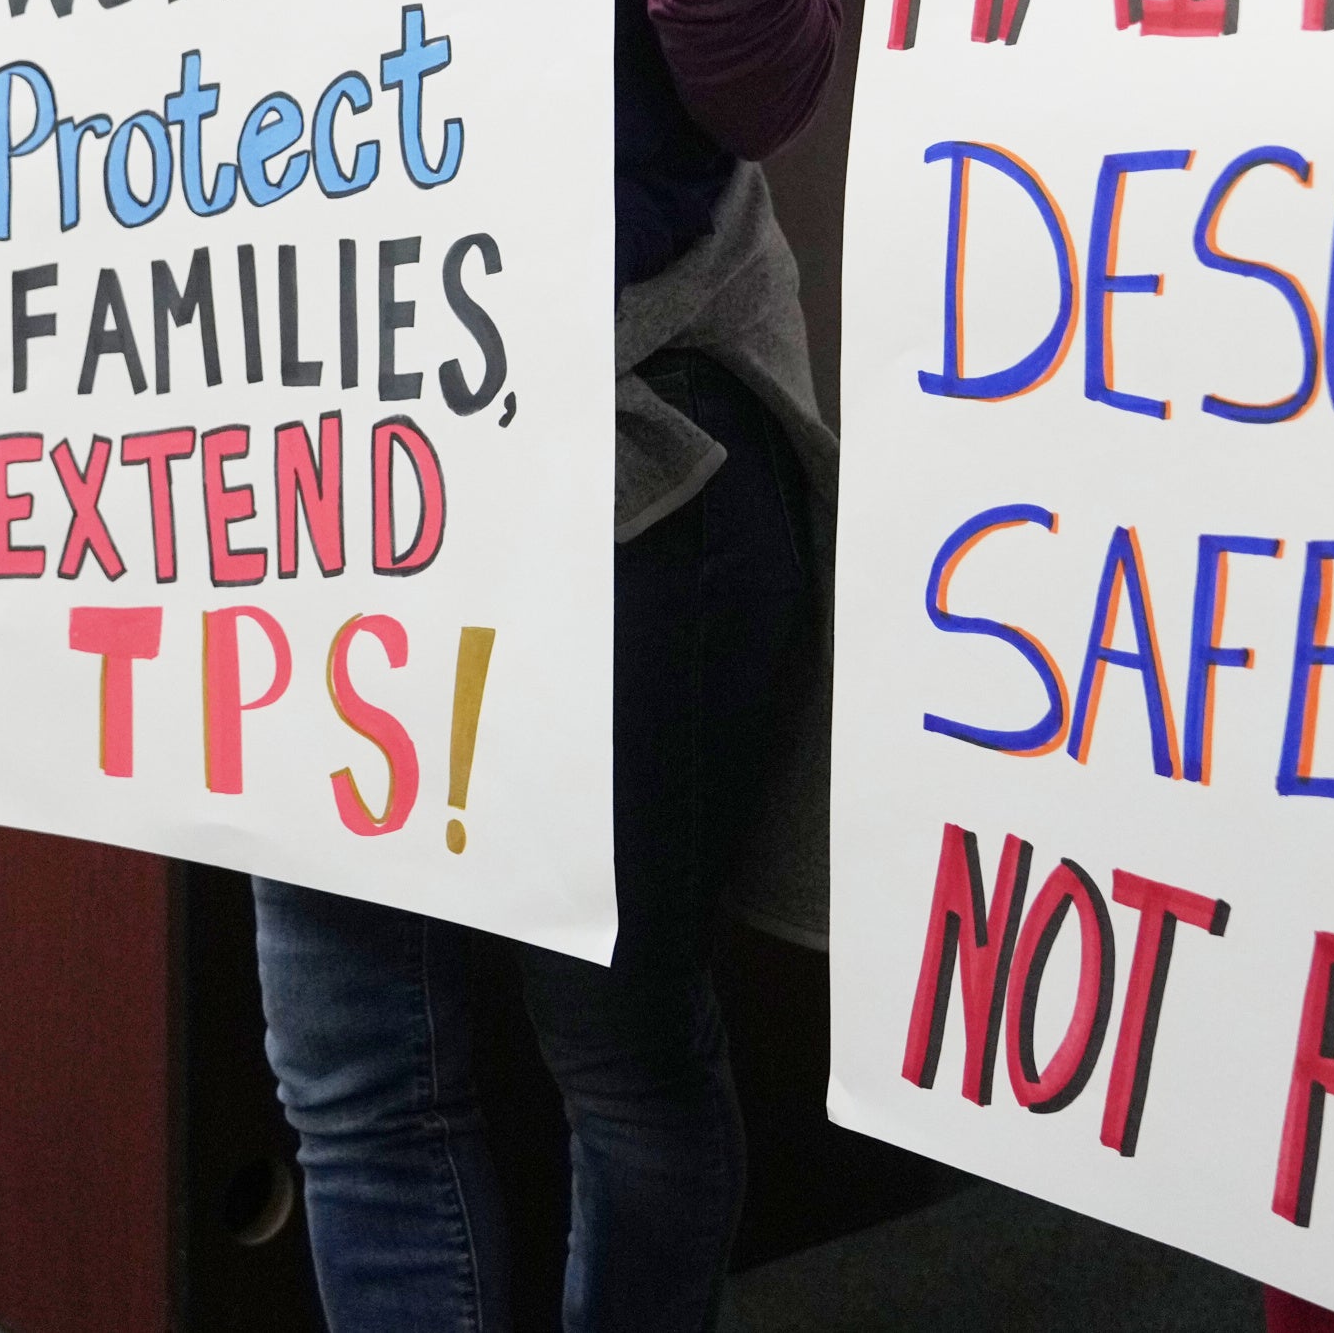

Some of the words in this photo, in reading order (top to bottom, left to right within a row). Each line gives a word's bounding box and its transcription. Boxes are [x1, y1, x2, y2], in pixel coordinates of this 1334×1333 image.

[11, 232, 517, 429] FAMILIES,
[68, 605, 496, 855] TPS!
[901, 823, 1231, 1157] NOT
